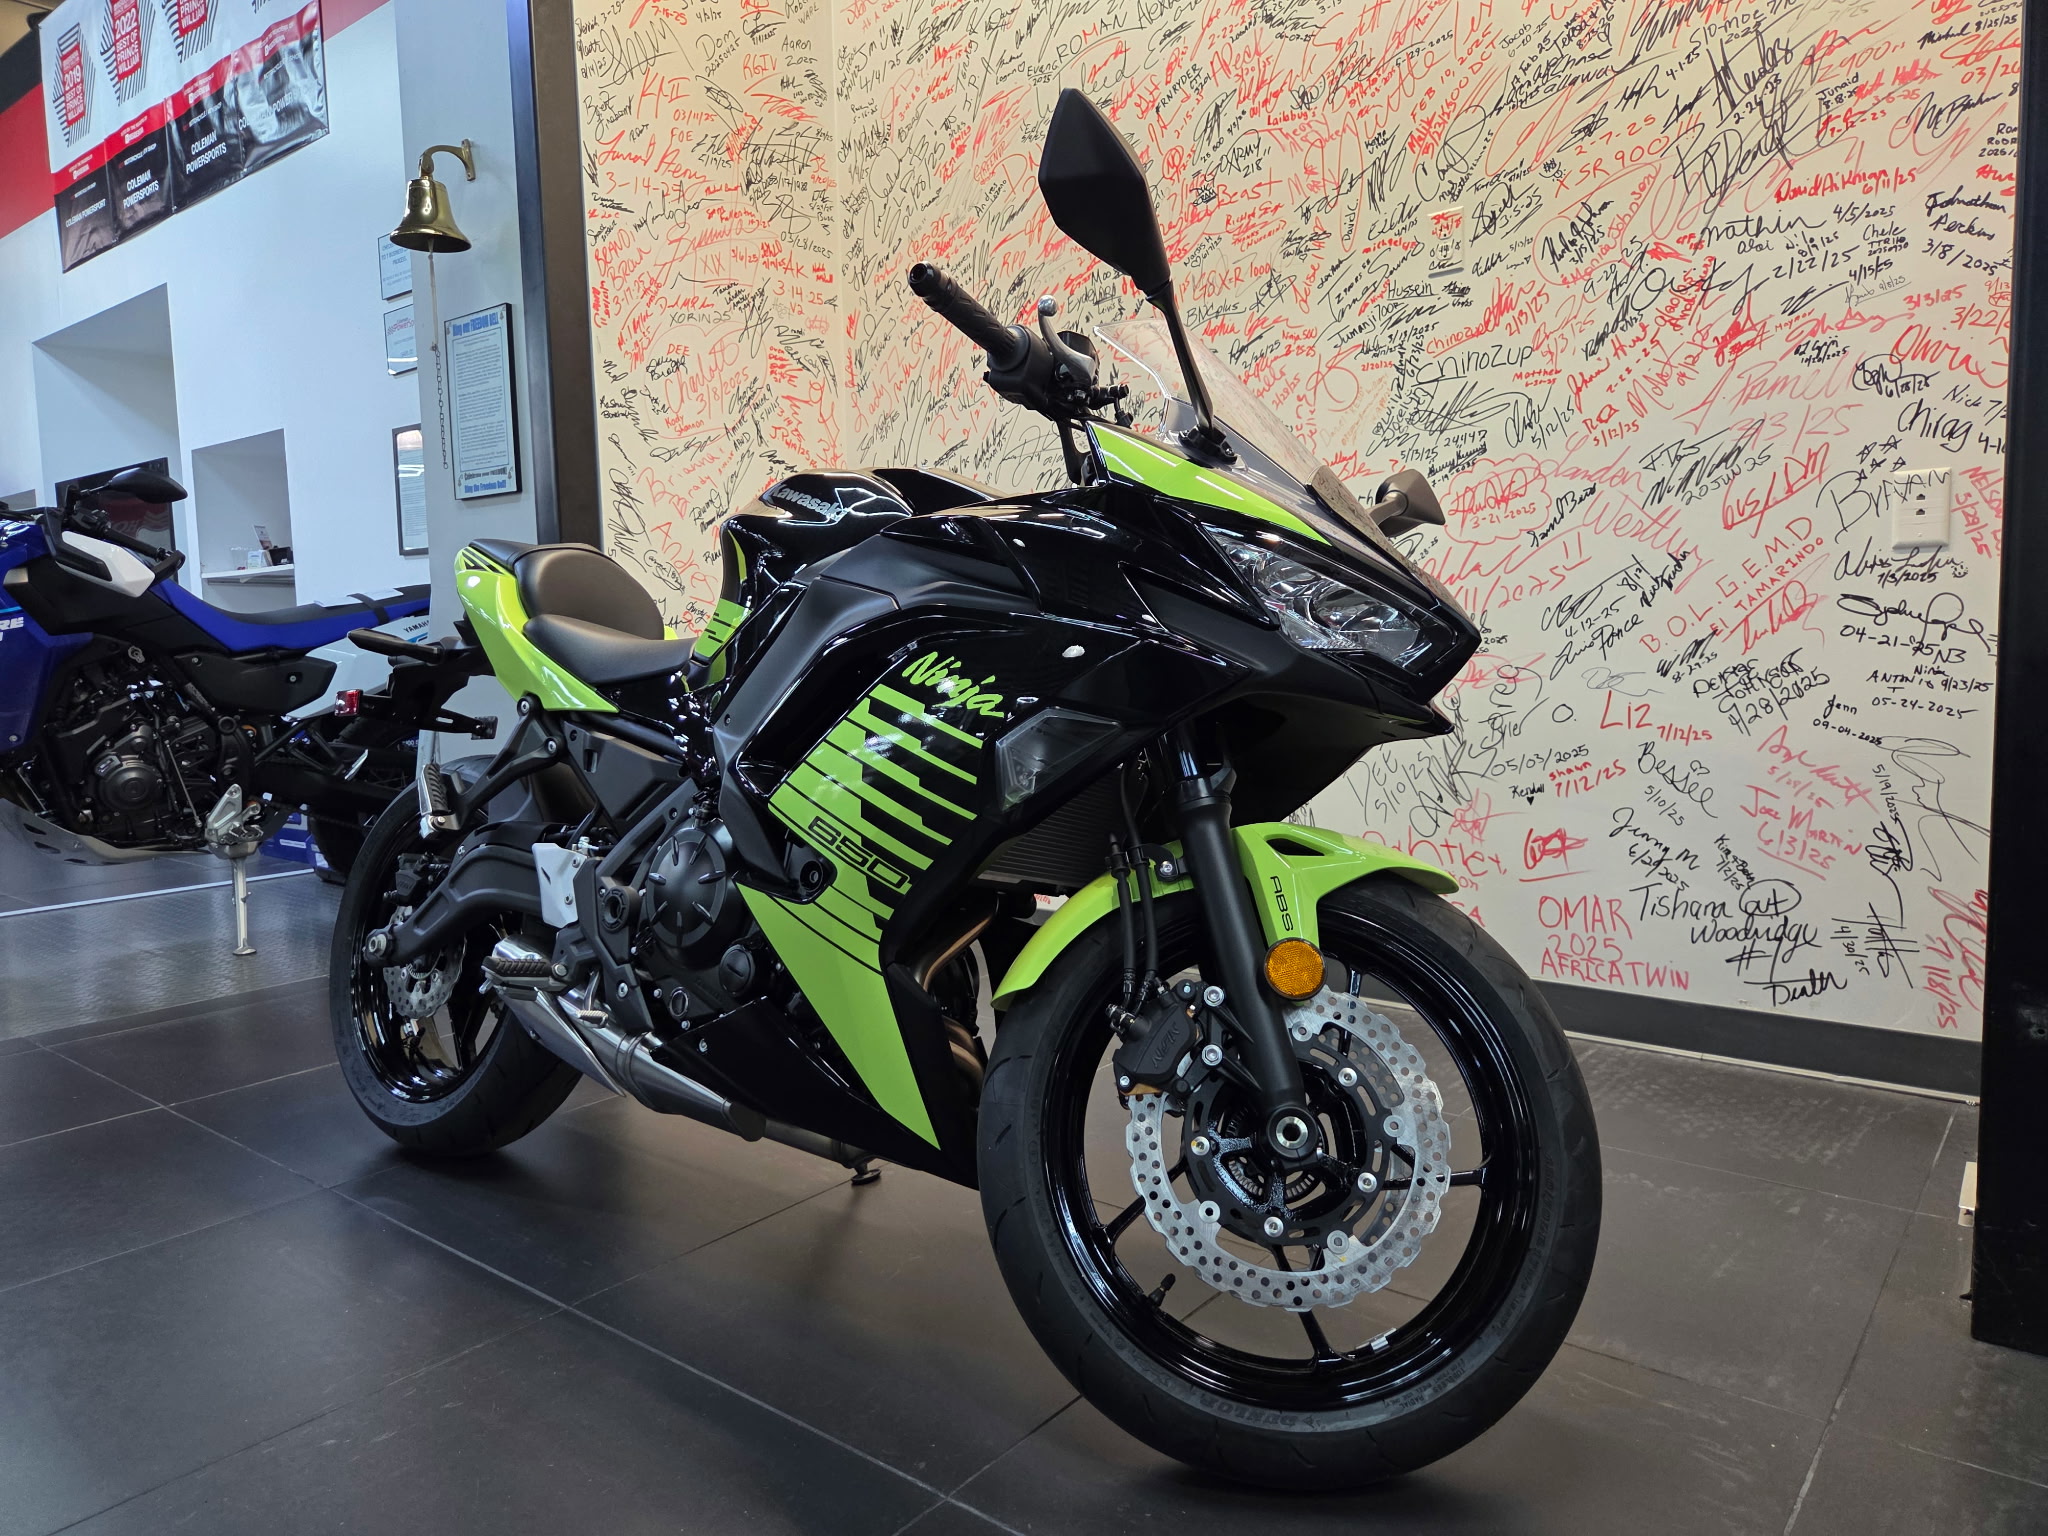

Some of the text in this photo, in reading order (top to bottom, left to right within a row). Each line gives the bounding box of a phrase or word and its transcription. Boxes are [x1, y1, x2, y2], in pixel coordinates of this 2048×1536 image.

[115, 8, 138, 37] 2022
[116, 29, 138, 54] BEST OF
[1499, 23, 1532, 50] Jacob
[117, 41, 139, 64] PRINCE
[118, 53, 140, 75] WILLIAM
[785, 55, 818, 66] 2025
[64, 65, 81, 90] 2019
[1816, 72, 1860, 101] Junaid
[65, 83, 82, 102] BEST OF
[66, 94, 83, 112] PRINCE
[673, 109, 718, 123] 03/11/25
[191, 130, 217, 155] COLEMAN
[1614, 135, 1671, 165] 900
[185, 142, 227, 174] POWERSPORTS
[1242, 157, 1263, 178] 218
[126, 169, 151, 191] COLEMAN
[123, 180, 159, 209] POWERSPORTS
[1832, 202, 1896, 226] 4/5/2025
[780, 231, 834, 259] 03/28/2025
[666, 344, 691, 357] DEE
[1469, 502, 1537, 529] 3-21-2025
[902, 651, 1004, 718] Ninja
[1871, 697, 1979, 719] 05-24-2025
[1656, 724, 1712, 746] 7/12/25
[1491, 745, 1589, 778] 05/03/2025
[1555, 759, 1626, 798] 7/12/25
[807, 815, 913, 891] 650
[1270, 875, 1294, 932] ABS
[1538, 894, 1633, 940] OMAR
[1548, 933, 1624, 963] 2025
